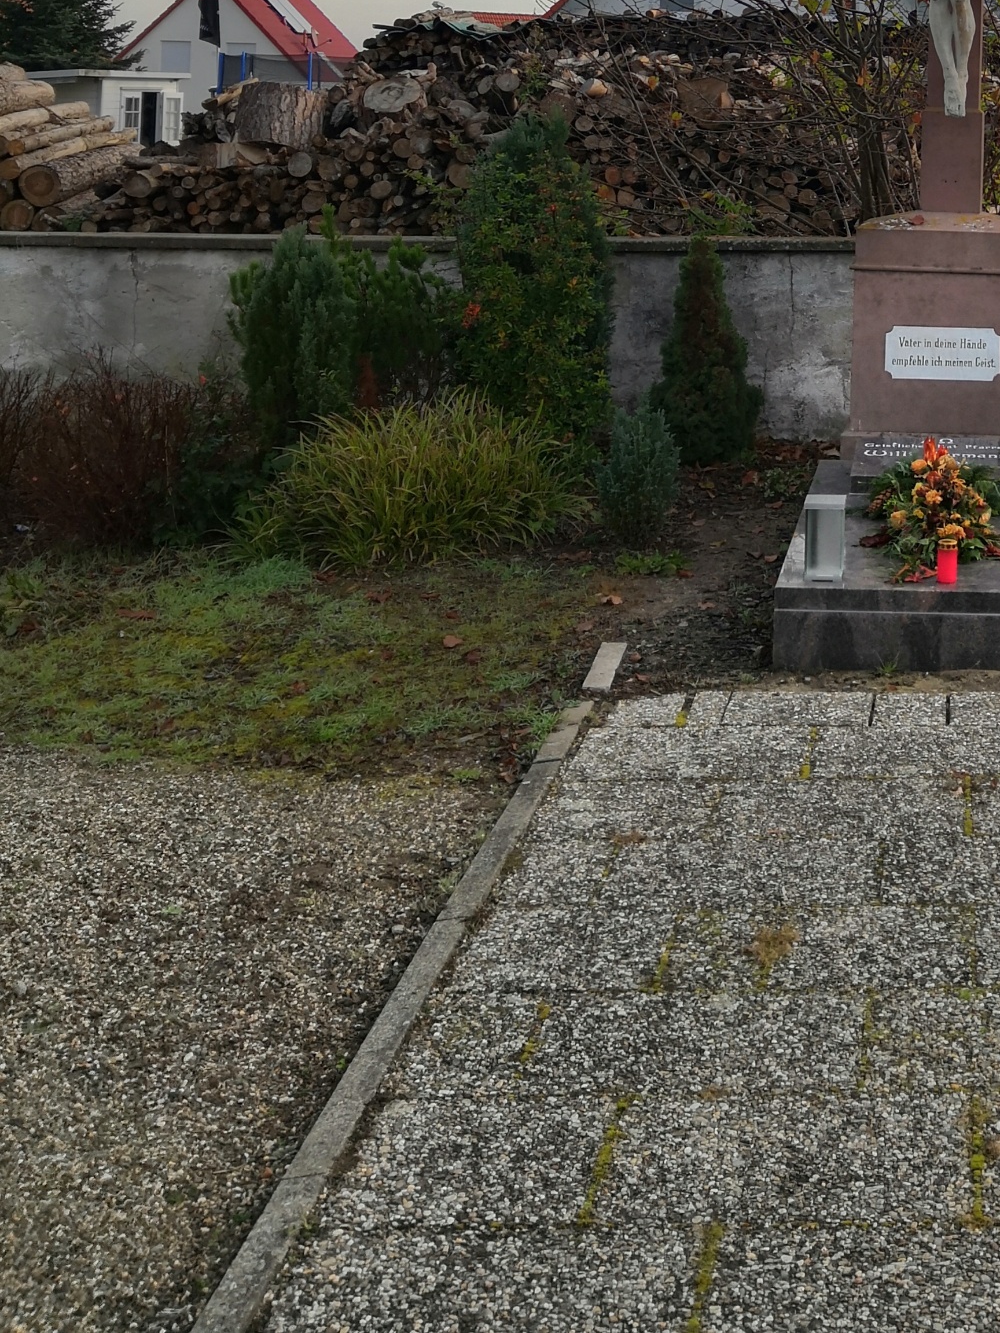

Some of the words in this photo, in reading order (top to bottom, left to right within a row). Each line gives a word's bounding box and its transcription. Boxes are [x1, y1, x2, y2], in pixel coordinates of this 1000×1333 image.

[898, 336, 922, 348] Vater
[924, 338, 932, 348] in
[934, 338, 957, 349] deine
[960, 338, 987, 350] Hände
[891, 355, 929, 368] empfehle
[931, 355, 943, 367] ich
[944, 357, 973, 368] meinen
[975, 356, 997, 368] Geist.
[864, 441, 923, 449] Geistliche
